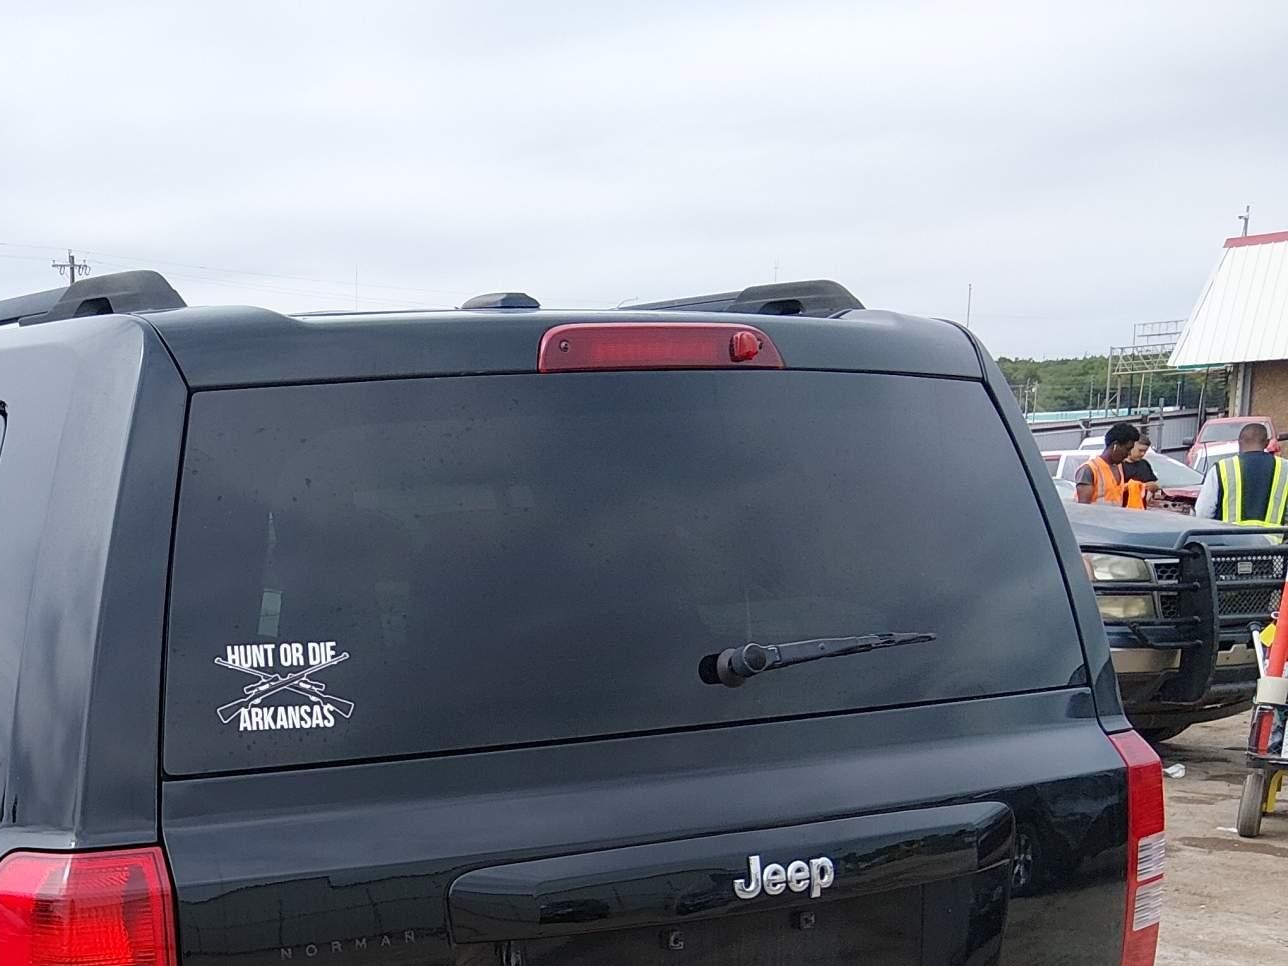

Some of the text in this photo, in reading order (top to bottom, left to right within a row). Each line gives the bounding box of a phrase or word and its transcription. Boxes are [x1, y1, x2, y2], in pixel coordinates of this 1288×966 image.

[226, 641, 337, 668] HUNT OR DIE
[239, 703, 336, 731] ARKANSAS
[733, 855, 835, 900] Jeep
